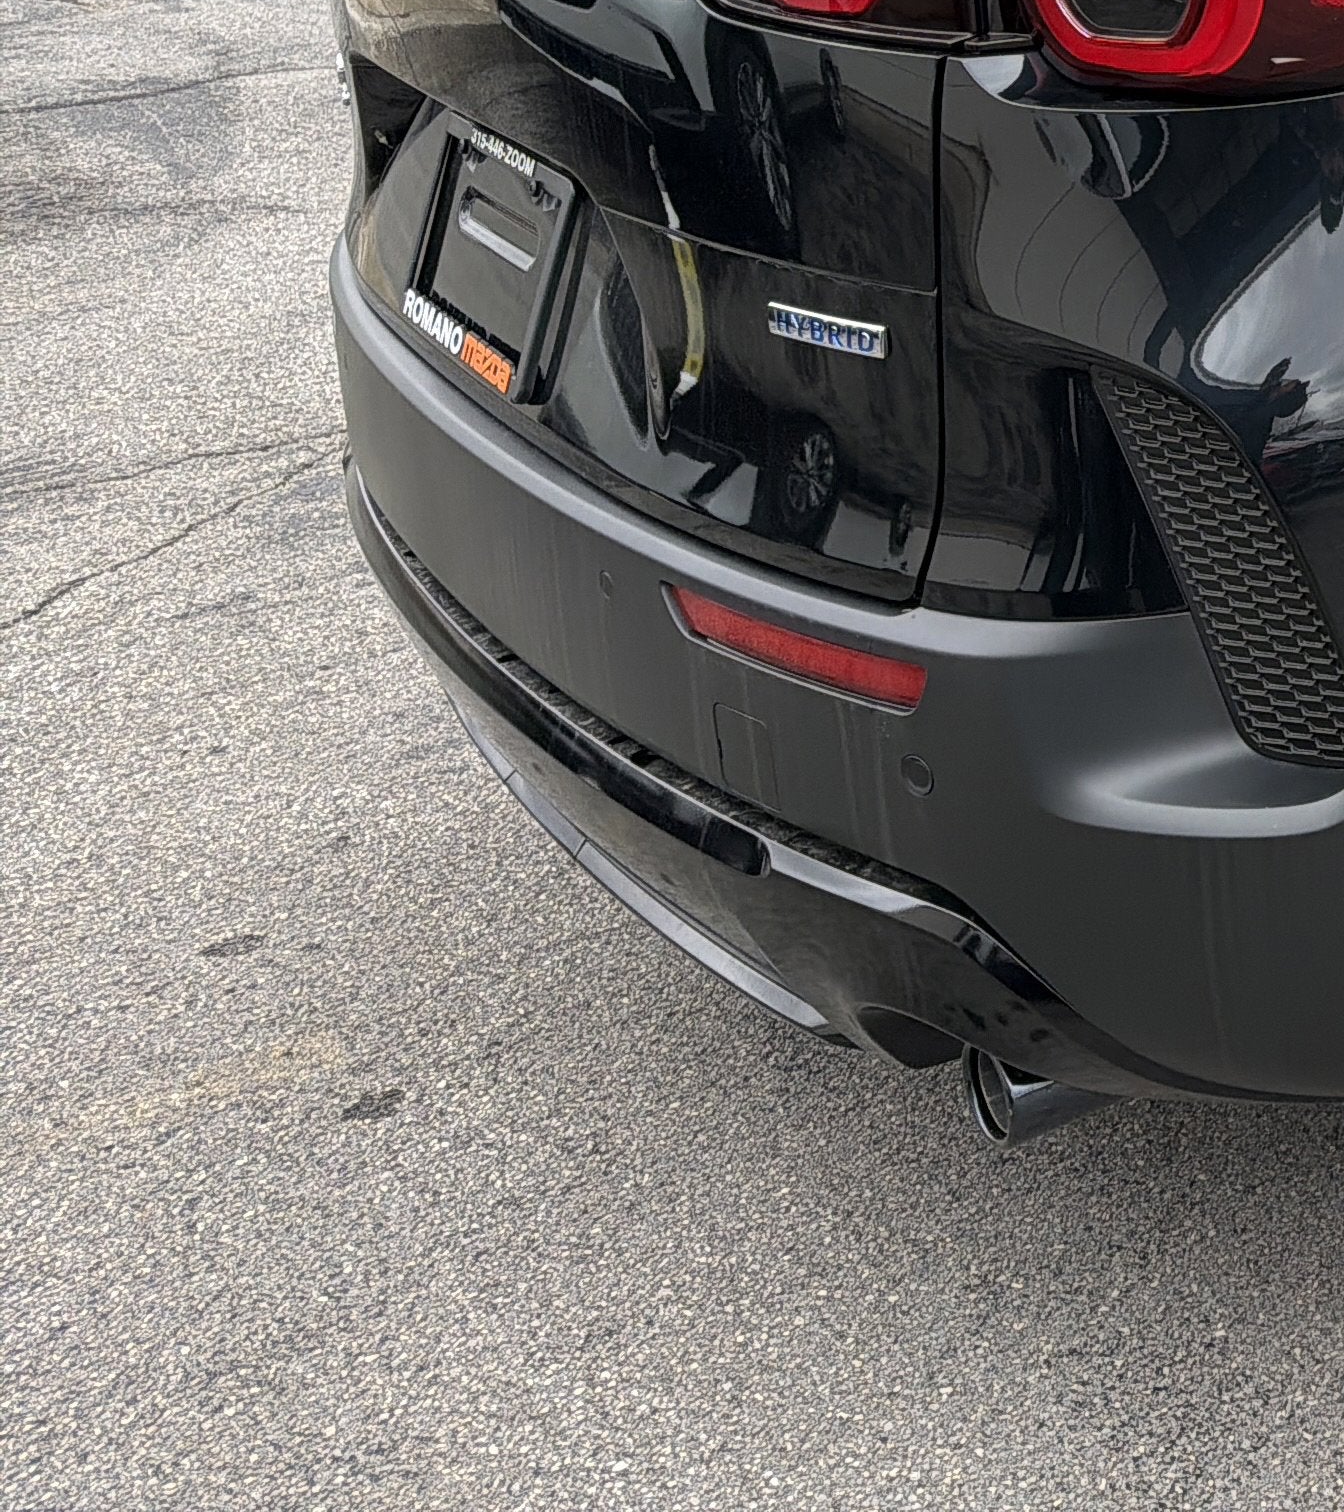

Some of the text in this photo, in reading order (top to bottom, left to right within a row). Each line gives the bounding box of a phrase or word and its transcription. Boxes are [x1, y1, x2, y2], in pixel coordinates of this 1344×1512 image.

[470, 127, 536, 178] 315-446-ZOOM
[402, 288, 514, 395] ROMANO mazda
[774, 307, 876, 354] HYBRID
